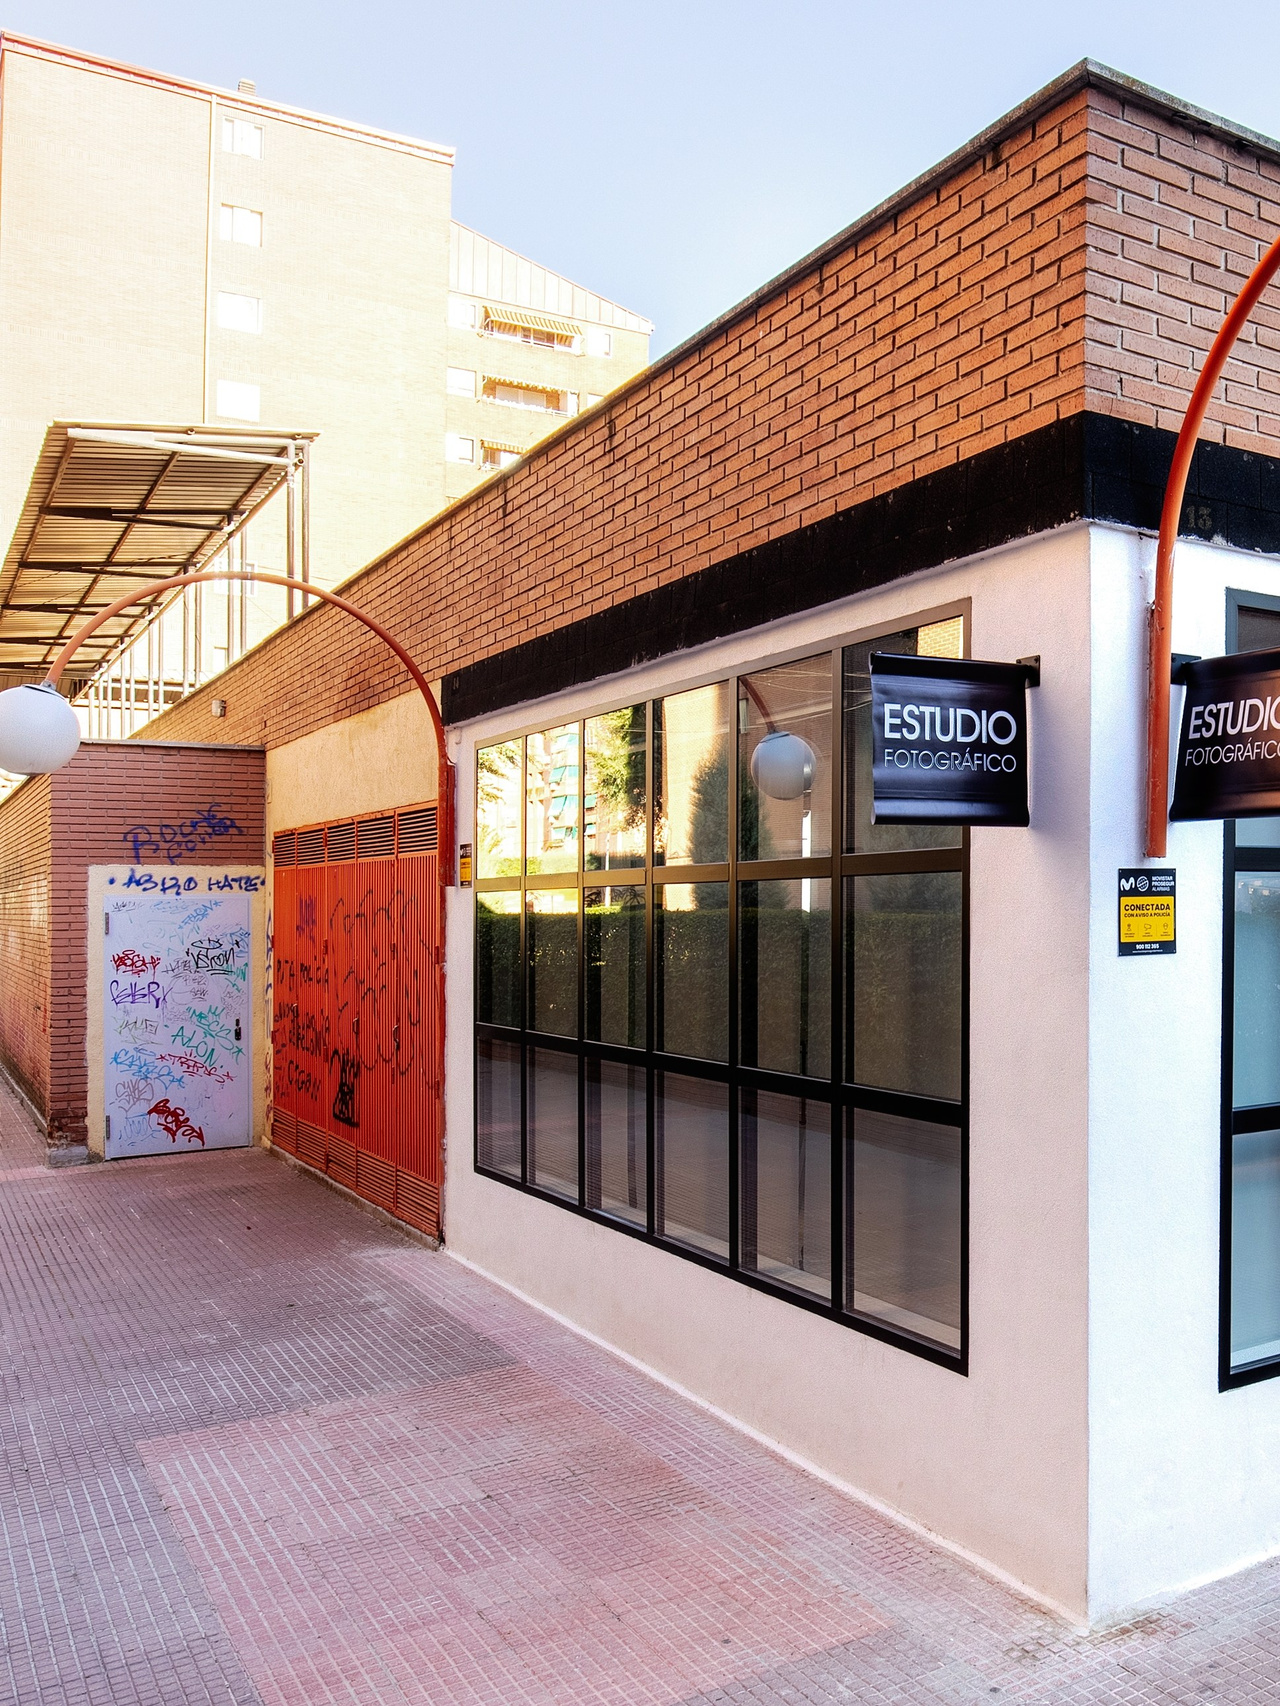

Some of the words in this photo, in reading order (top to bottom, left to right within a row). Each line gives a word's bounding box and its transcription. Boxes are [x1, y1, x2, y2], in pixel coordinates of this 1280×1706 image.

[884, 703, 1017, 745] ESTUDIO
[884, 748, 1017, 773] FOTOGRÁFICO
[1124, 903, 1171, 911] CONECTADA
